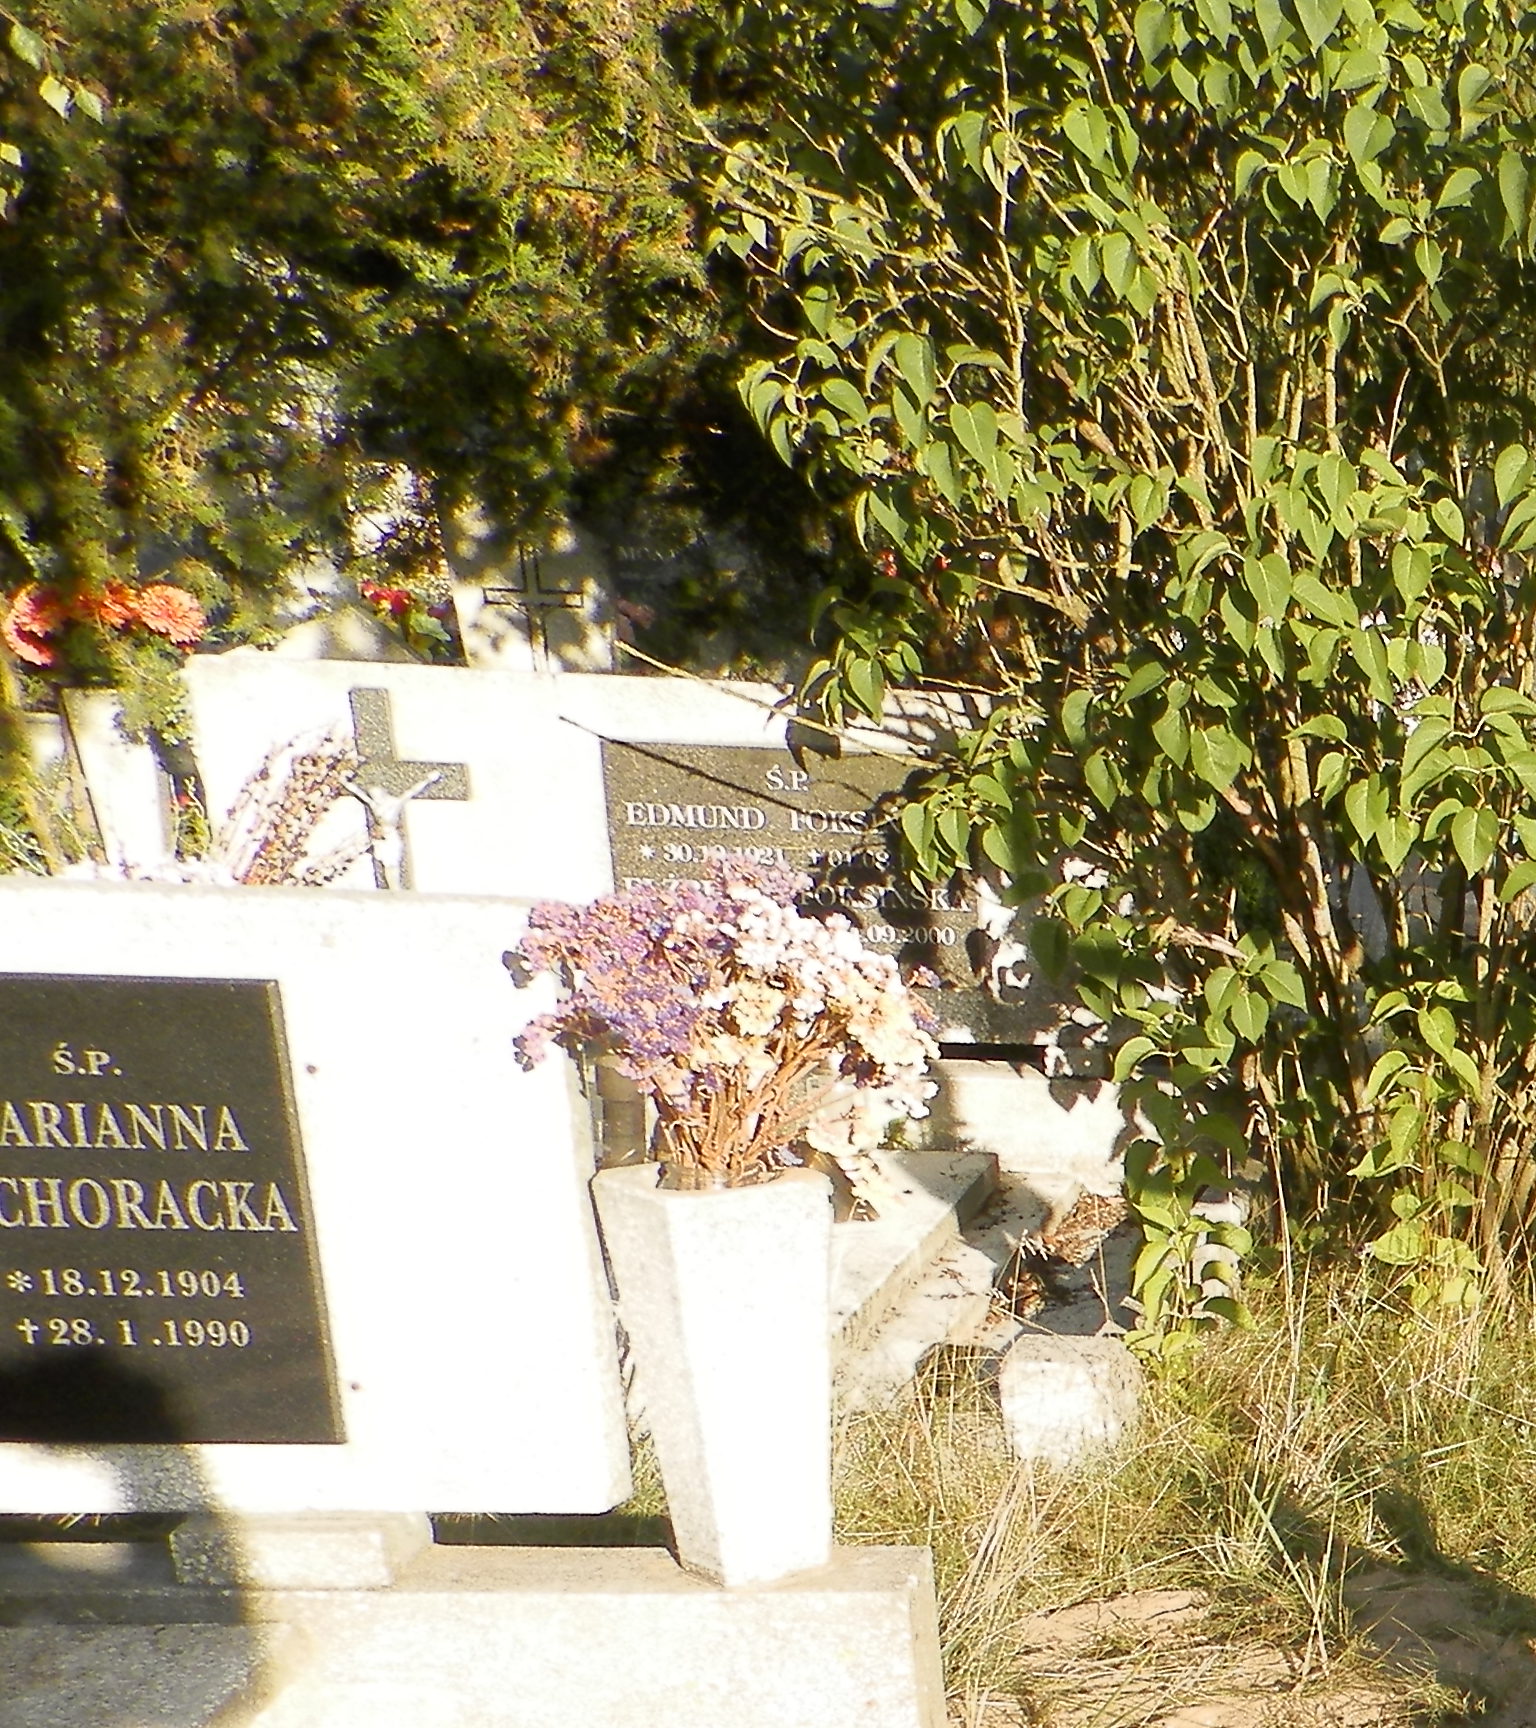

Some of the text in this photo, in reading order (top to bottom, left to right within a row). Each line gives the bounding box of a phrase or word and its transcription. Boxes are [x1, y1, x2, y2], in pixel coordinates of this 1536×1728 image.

[765, 764, 810, 792] Ś.P.
[625, 801, 766, 830] EDMUND
[52, 1042, 123, 1077] Ś.P.
[40, 1268, 245, 1299] 18.12.1904
